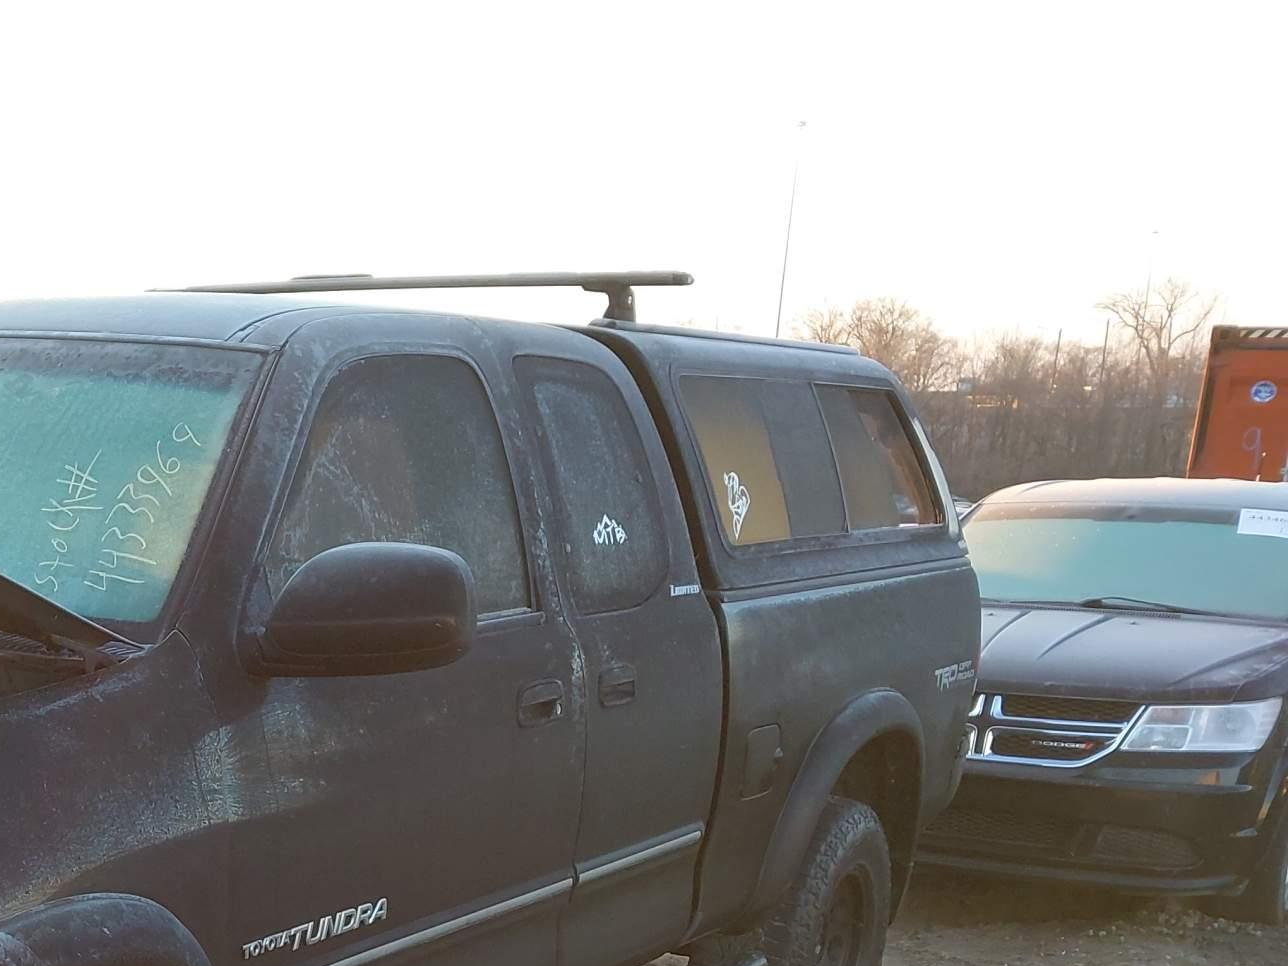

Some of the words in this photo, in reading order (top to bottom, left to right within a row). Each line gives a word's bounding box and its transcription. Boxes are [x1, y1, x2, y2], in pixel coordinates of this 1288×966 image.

[83, 421, 202, 592] 44333969
[593, 517, 627, 544] MTB
[935, 663, 958, 689] TRD
[1031, 739, 1084, 749] DODGE
[242, 930, 291, 960] TOYOTA
[291, 898, 388, 951] TUNDRA
